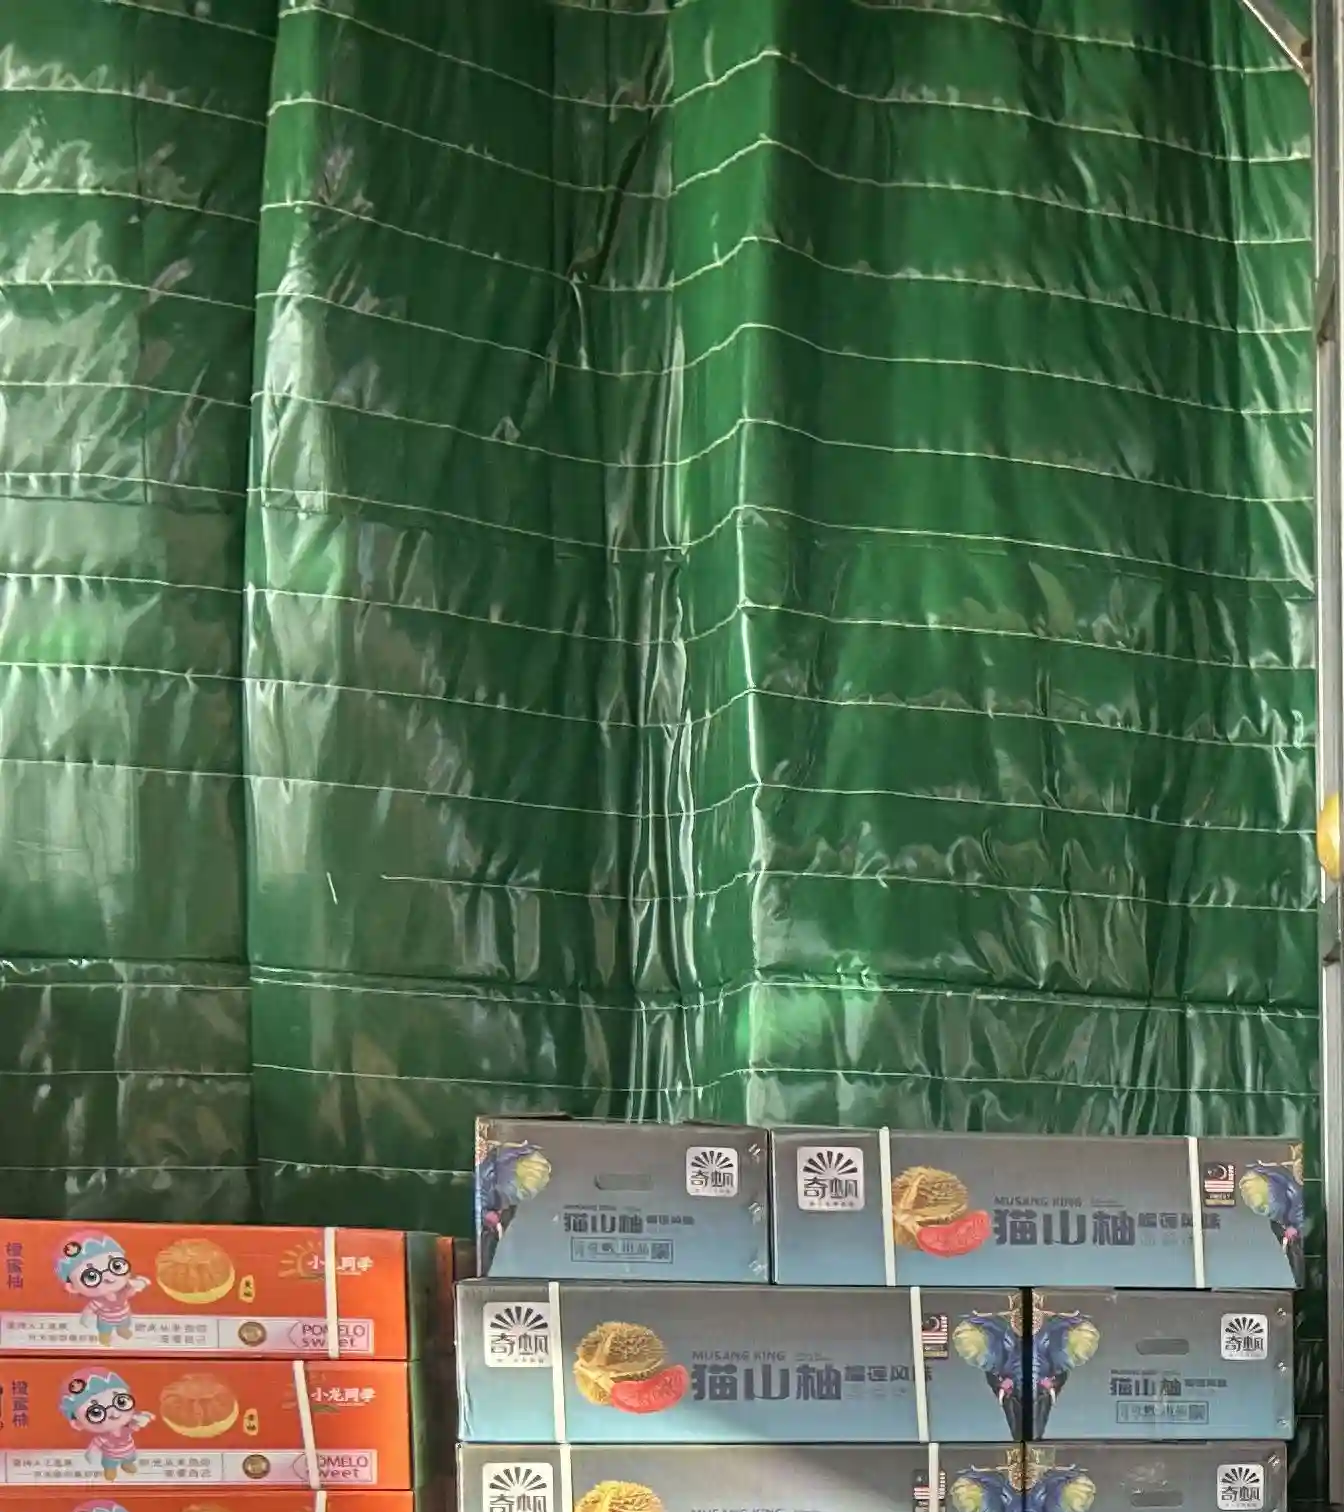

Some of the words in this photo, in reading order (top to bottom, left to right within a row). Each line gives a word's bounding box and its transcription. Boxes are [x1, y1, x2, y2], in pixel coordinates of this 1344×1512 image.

[994, 1208, 1135, 1247] 猫山柚
[302, 1338, 358, 1348] swet
[691, 1351, 749, 1361] MUSANG
[754, 1351, 786, 1361] KING
[691, 1363, 842, 1401] 猫山柚
[311, 1387, 377, 1403] 小龙同学
[315, 1456, 368, 1469] OMELO
